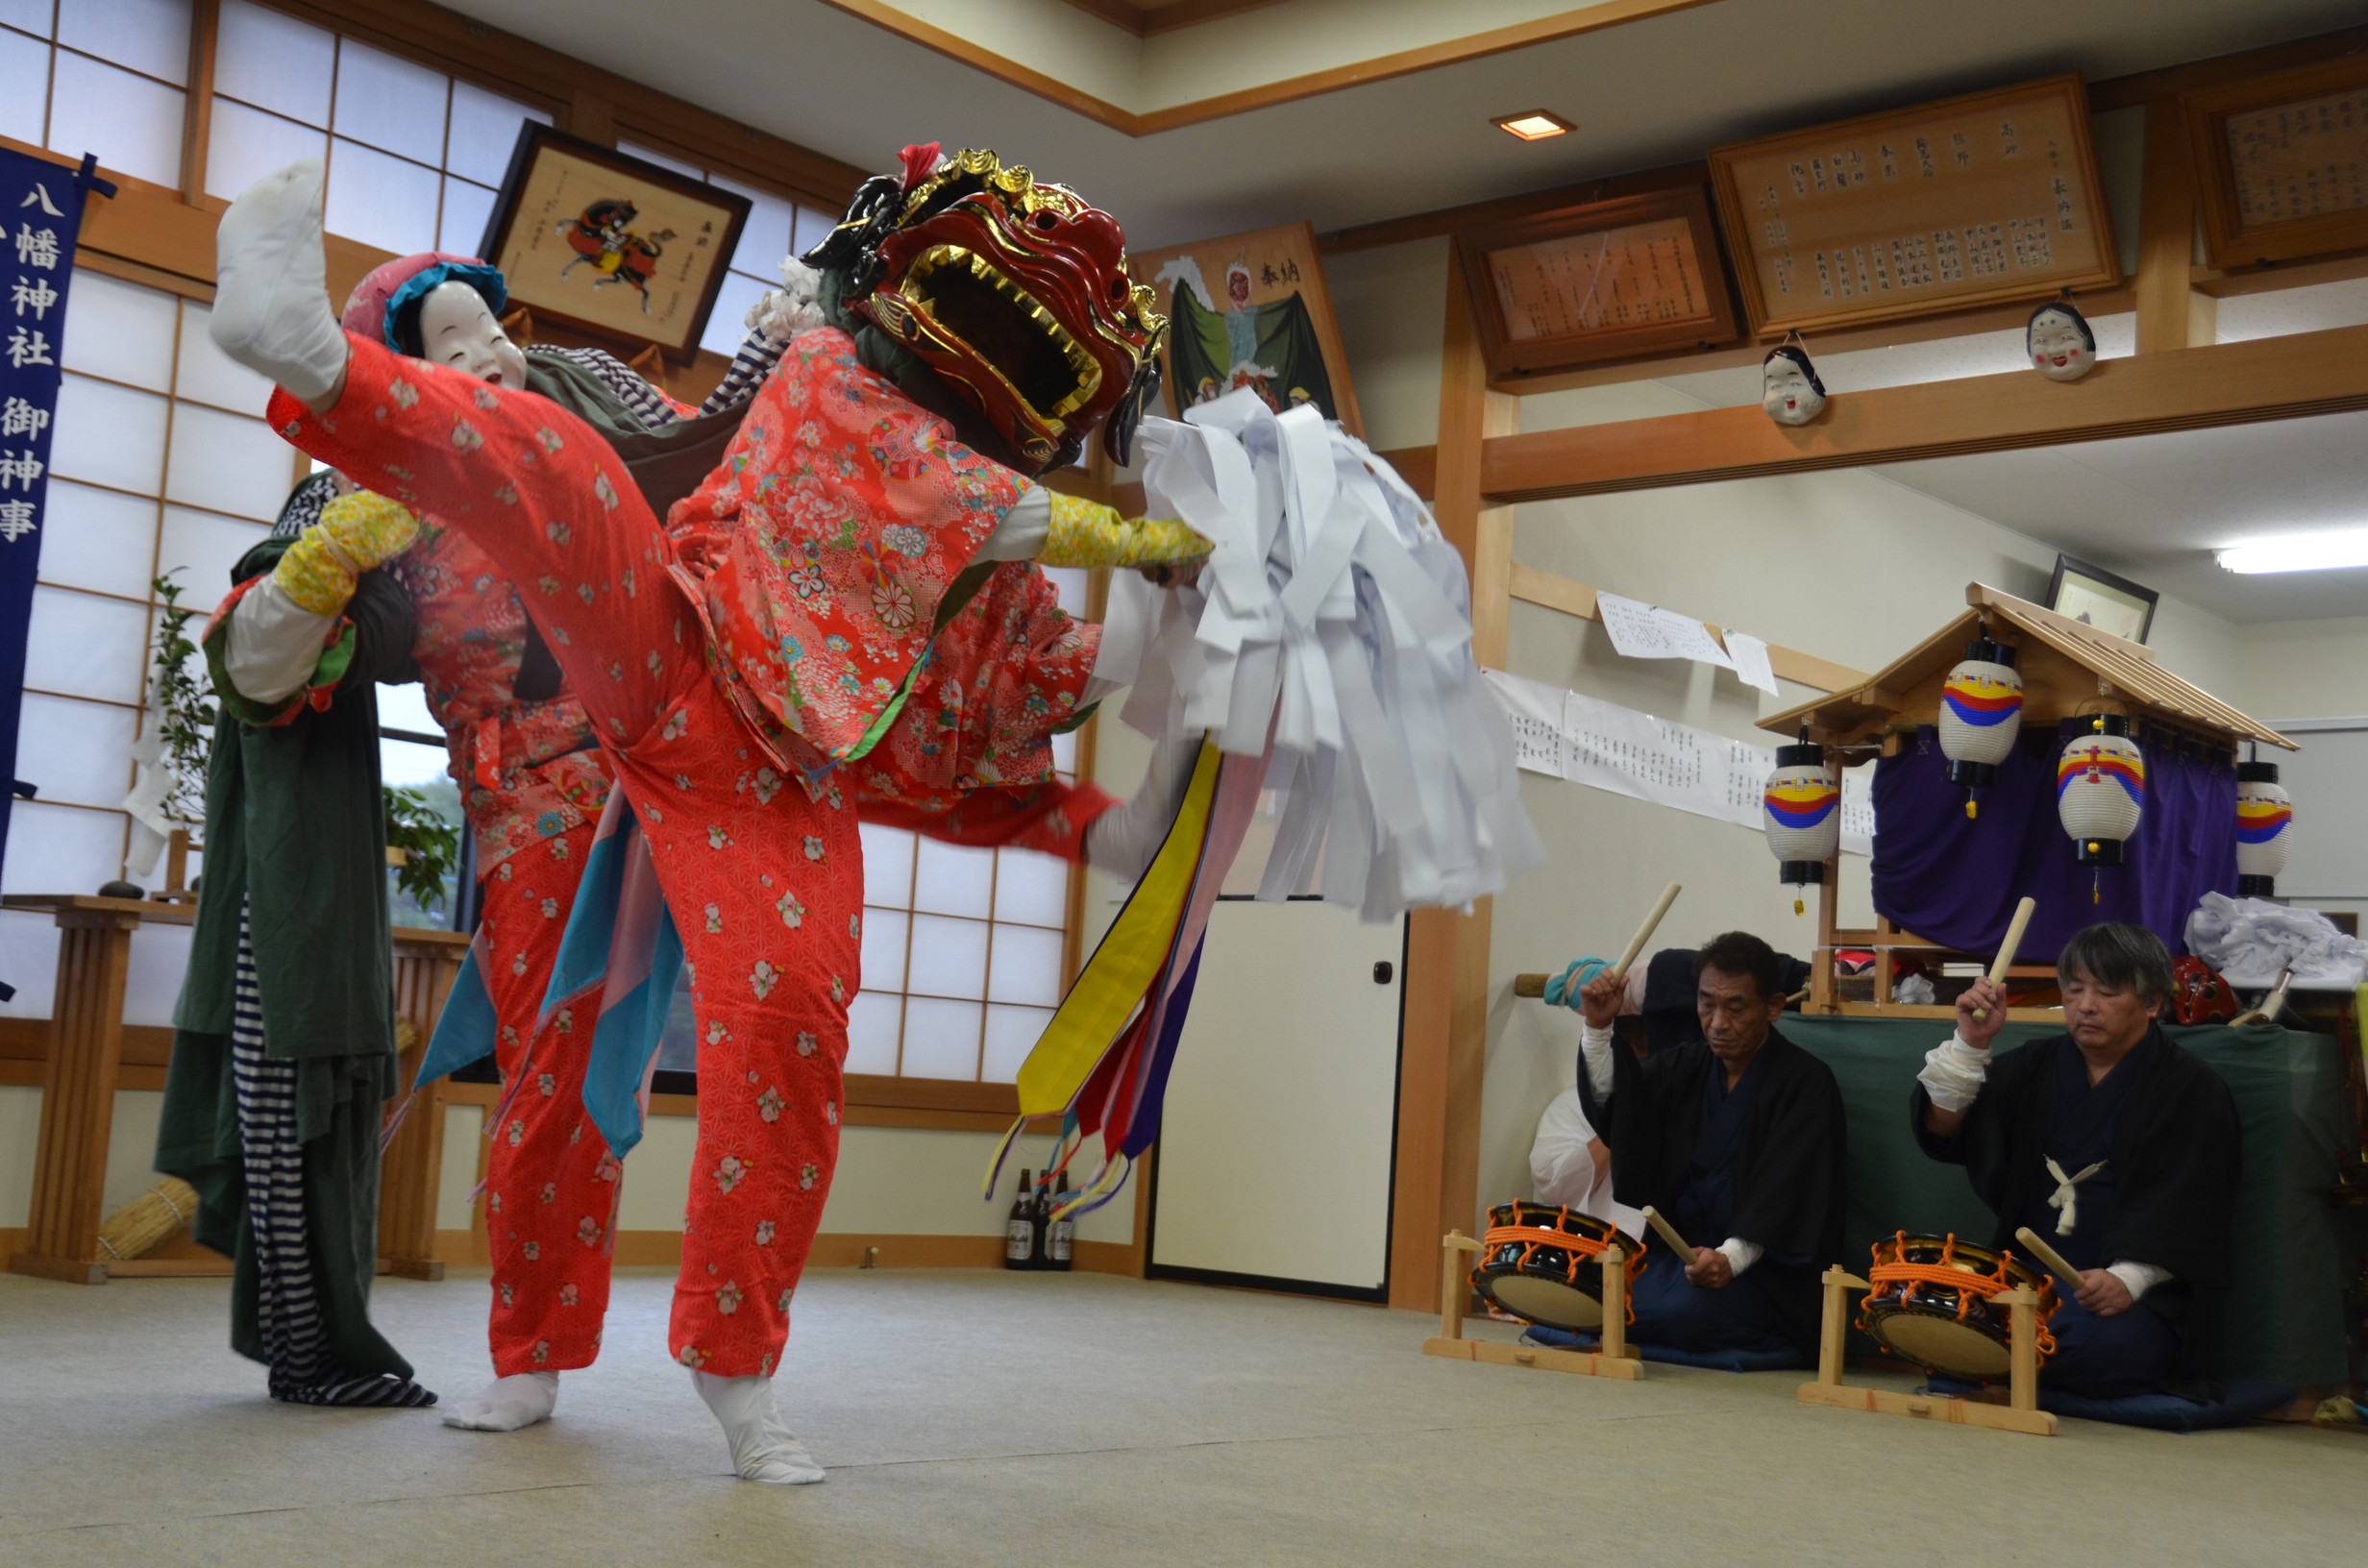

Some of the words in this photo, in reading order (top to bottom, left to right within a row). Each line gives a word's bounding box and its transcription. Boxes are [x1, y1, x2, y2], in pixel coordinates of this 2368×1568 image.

[6, 182, 65, 369] 八幡神社
[1260, 257, 1300, 288] 奉納
[0, 396, 49, 543] 御神事
